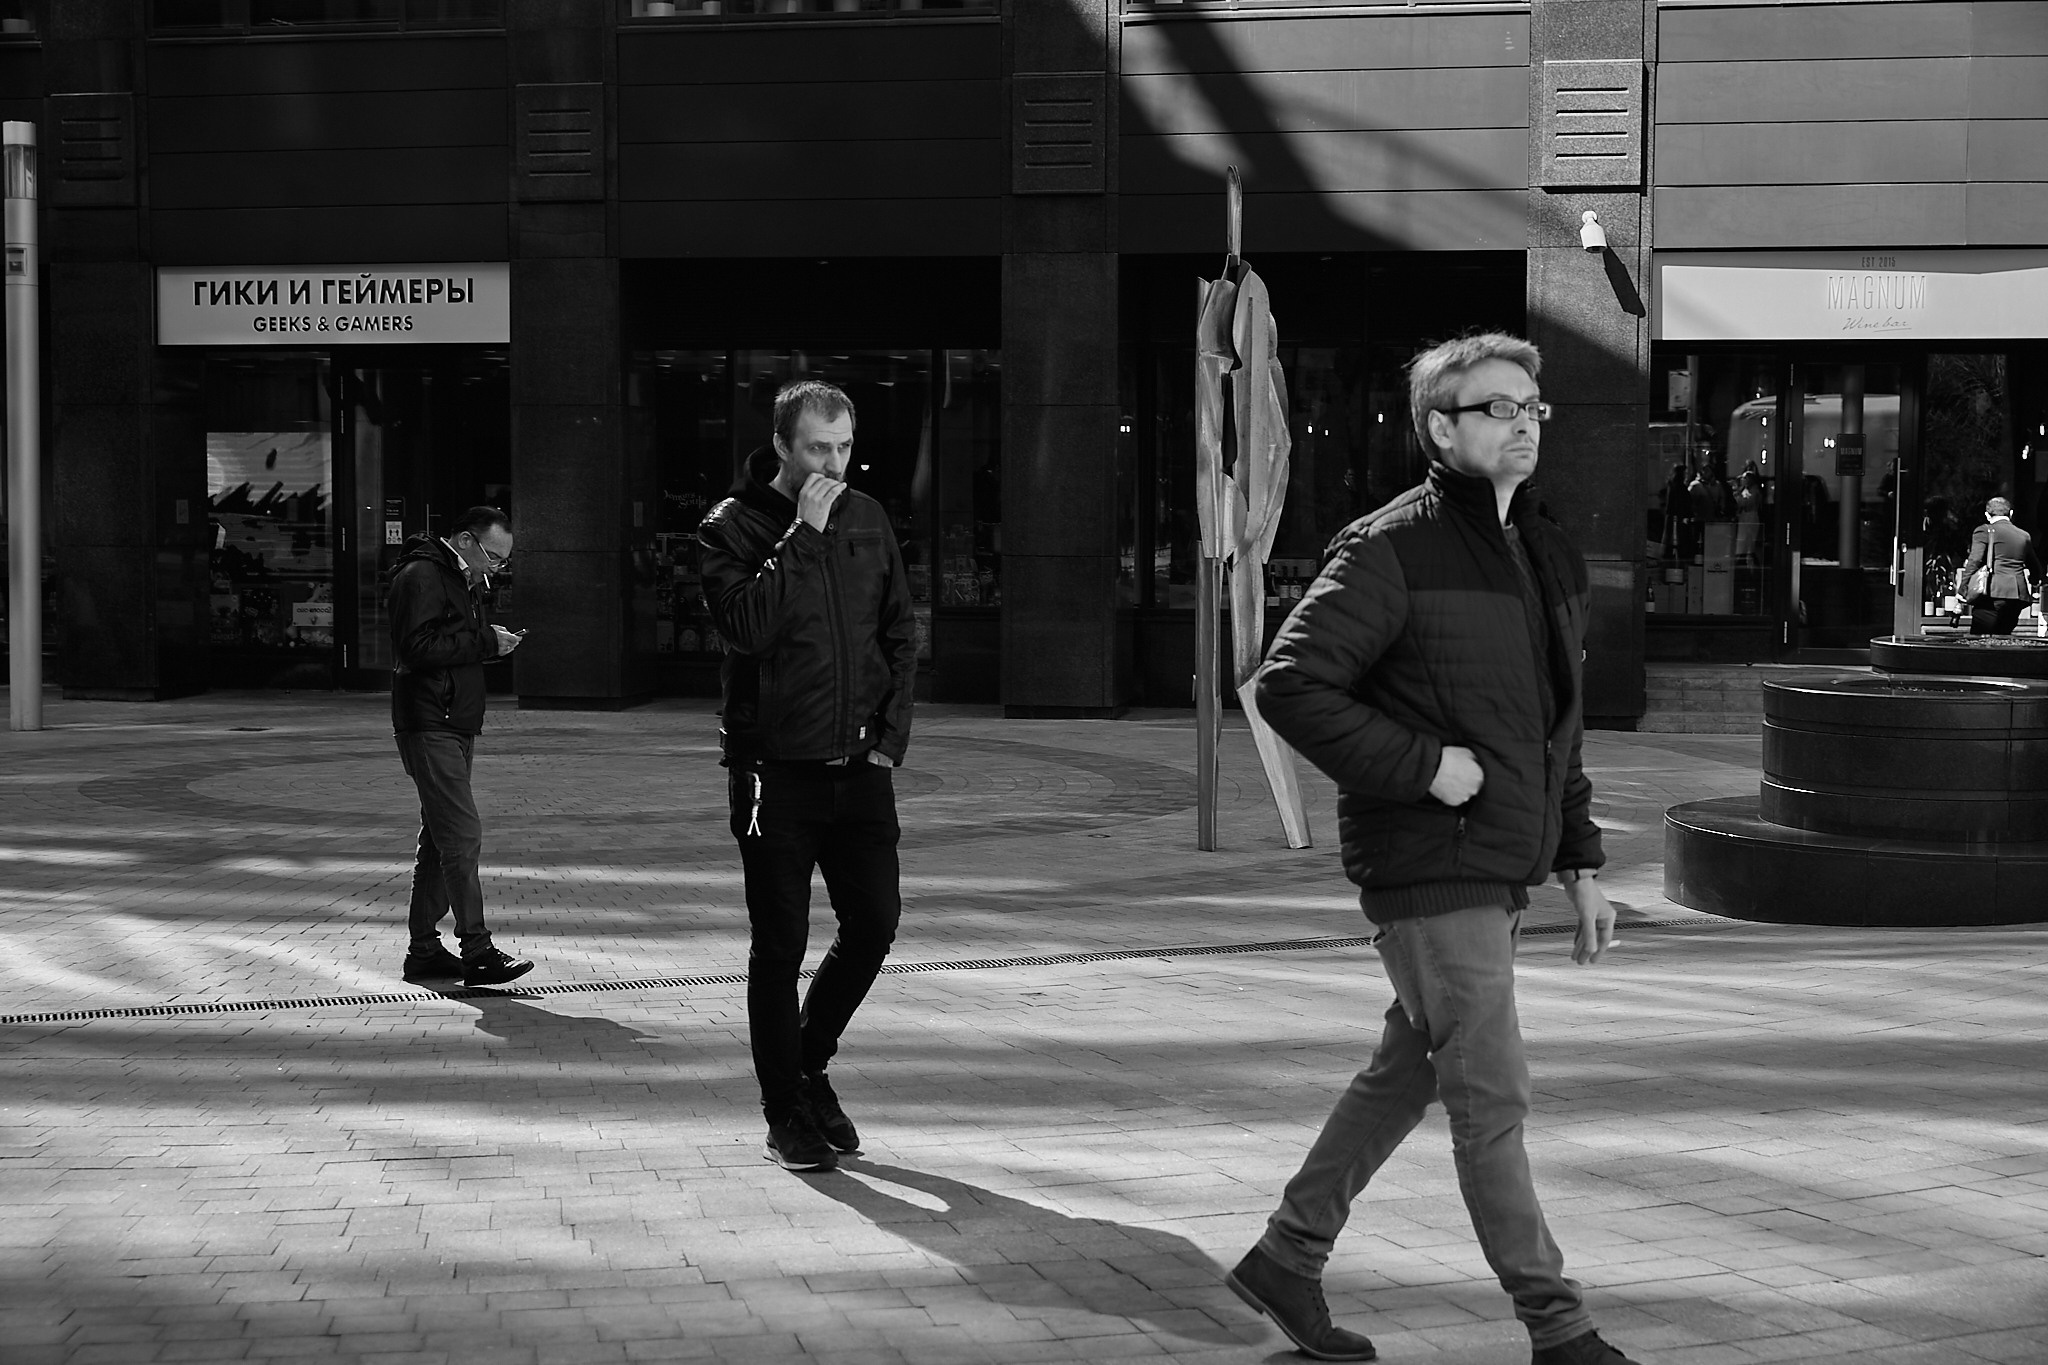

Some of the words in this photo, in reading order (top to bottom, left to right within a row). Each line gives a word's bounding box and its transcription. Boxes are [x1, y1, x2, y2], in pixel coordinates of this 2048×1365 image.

[1861, 256, 1875, 268] EST
[1879, 256, 1896, 268] 2015
[193, 280, 278, 306] ГИКИ
[289, 280, 311, 305] И
[321, 273, 474, 305] ГЕЙМЕРЫ
[1827, 275, 1926, 310] MAGNUM
[253, 316, 311, 332] GEEKS
[316, 316, 330, 332] &
[335, 315, 414, 332] GAMERS
